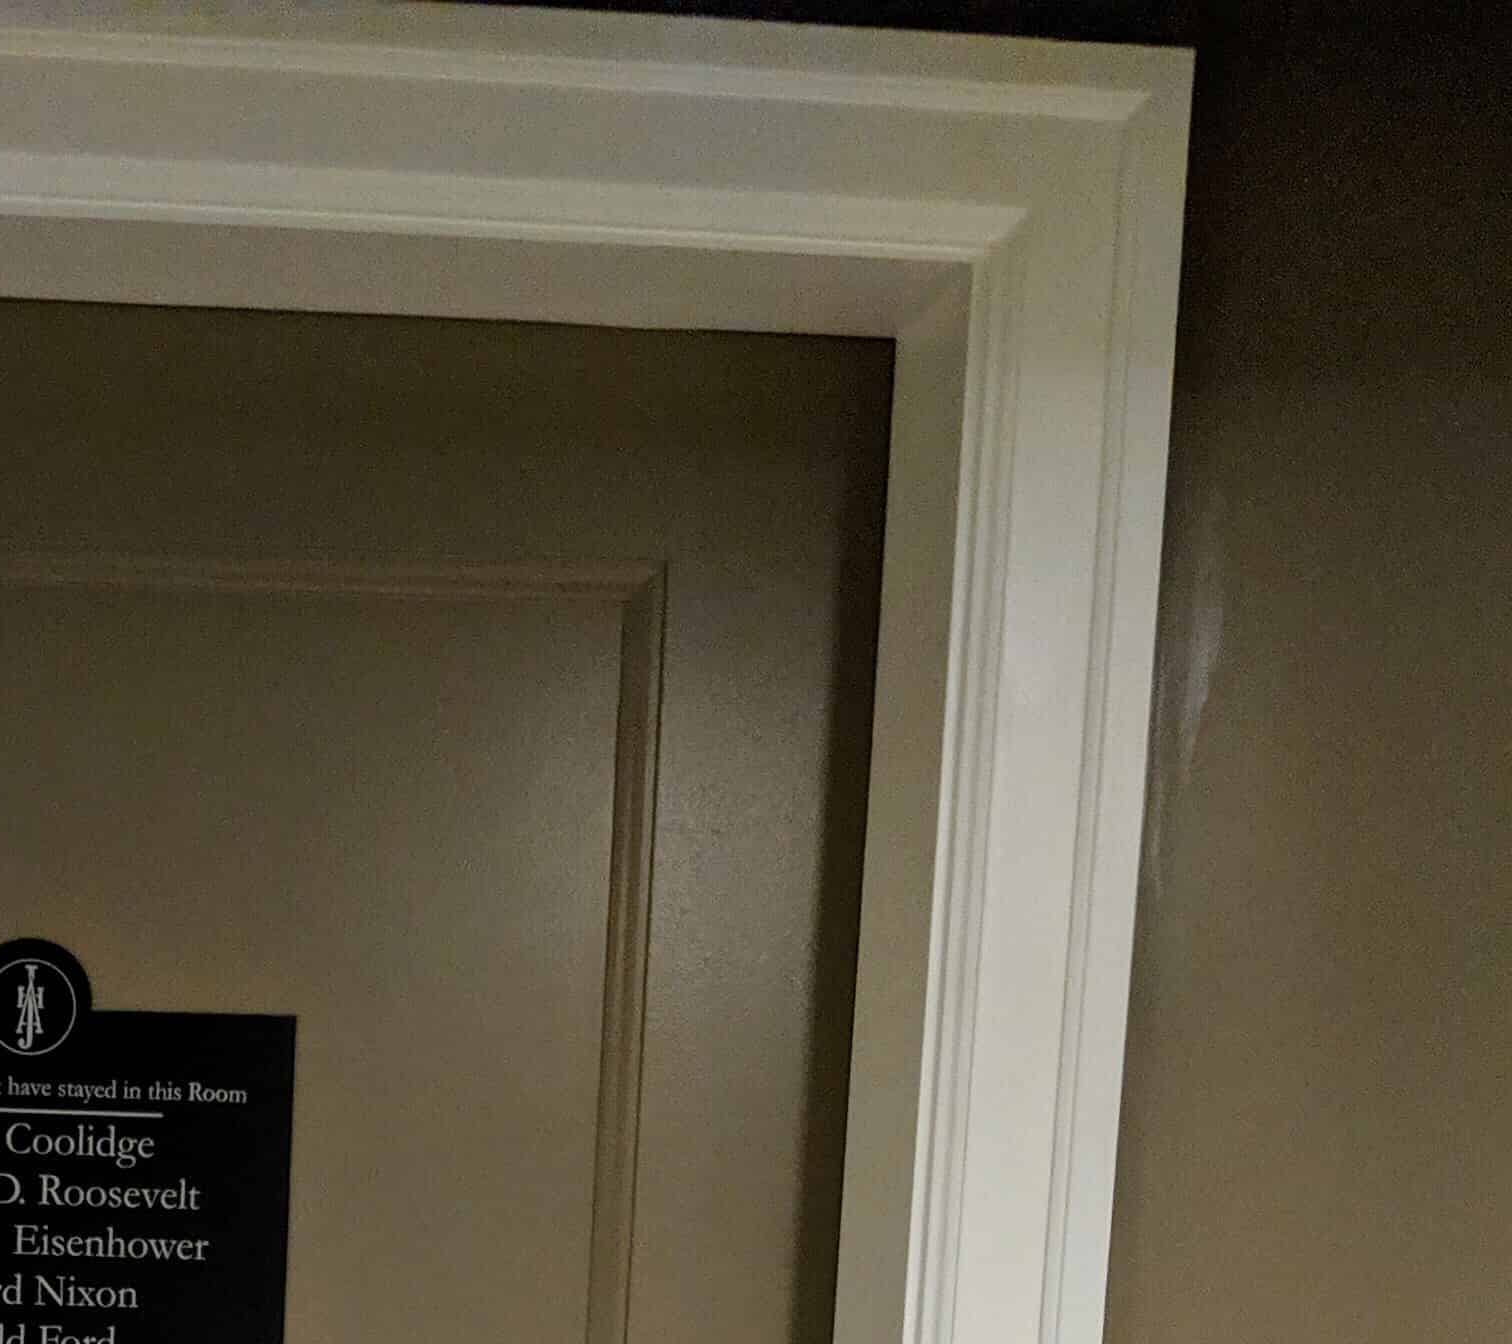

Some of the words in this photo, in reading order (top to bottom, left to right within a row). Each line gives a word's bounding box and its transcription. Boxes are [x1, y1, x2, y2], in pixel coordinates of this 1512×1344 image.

[8, 1076, 52, 1097] have
[58, 1079, 117, 1104] stayed
[123, 1081, 141, 1100] in
[148, 1081, 182, 1101] this
[188, 1082, 248, 1103] Room
[5, 1122, 155, 1169] Coolidge
[39, 1174, 201, 1210] Roosevelt
[13, 1224, 209, 1261] Eisenhower
[35, 1275, 138, 1308] Nixon
